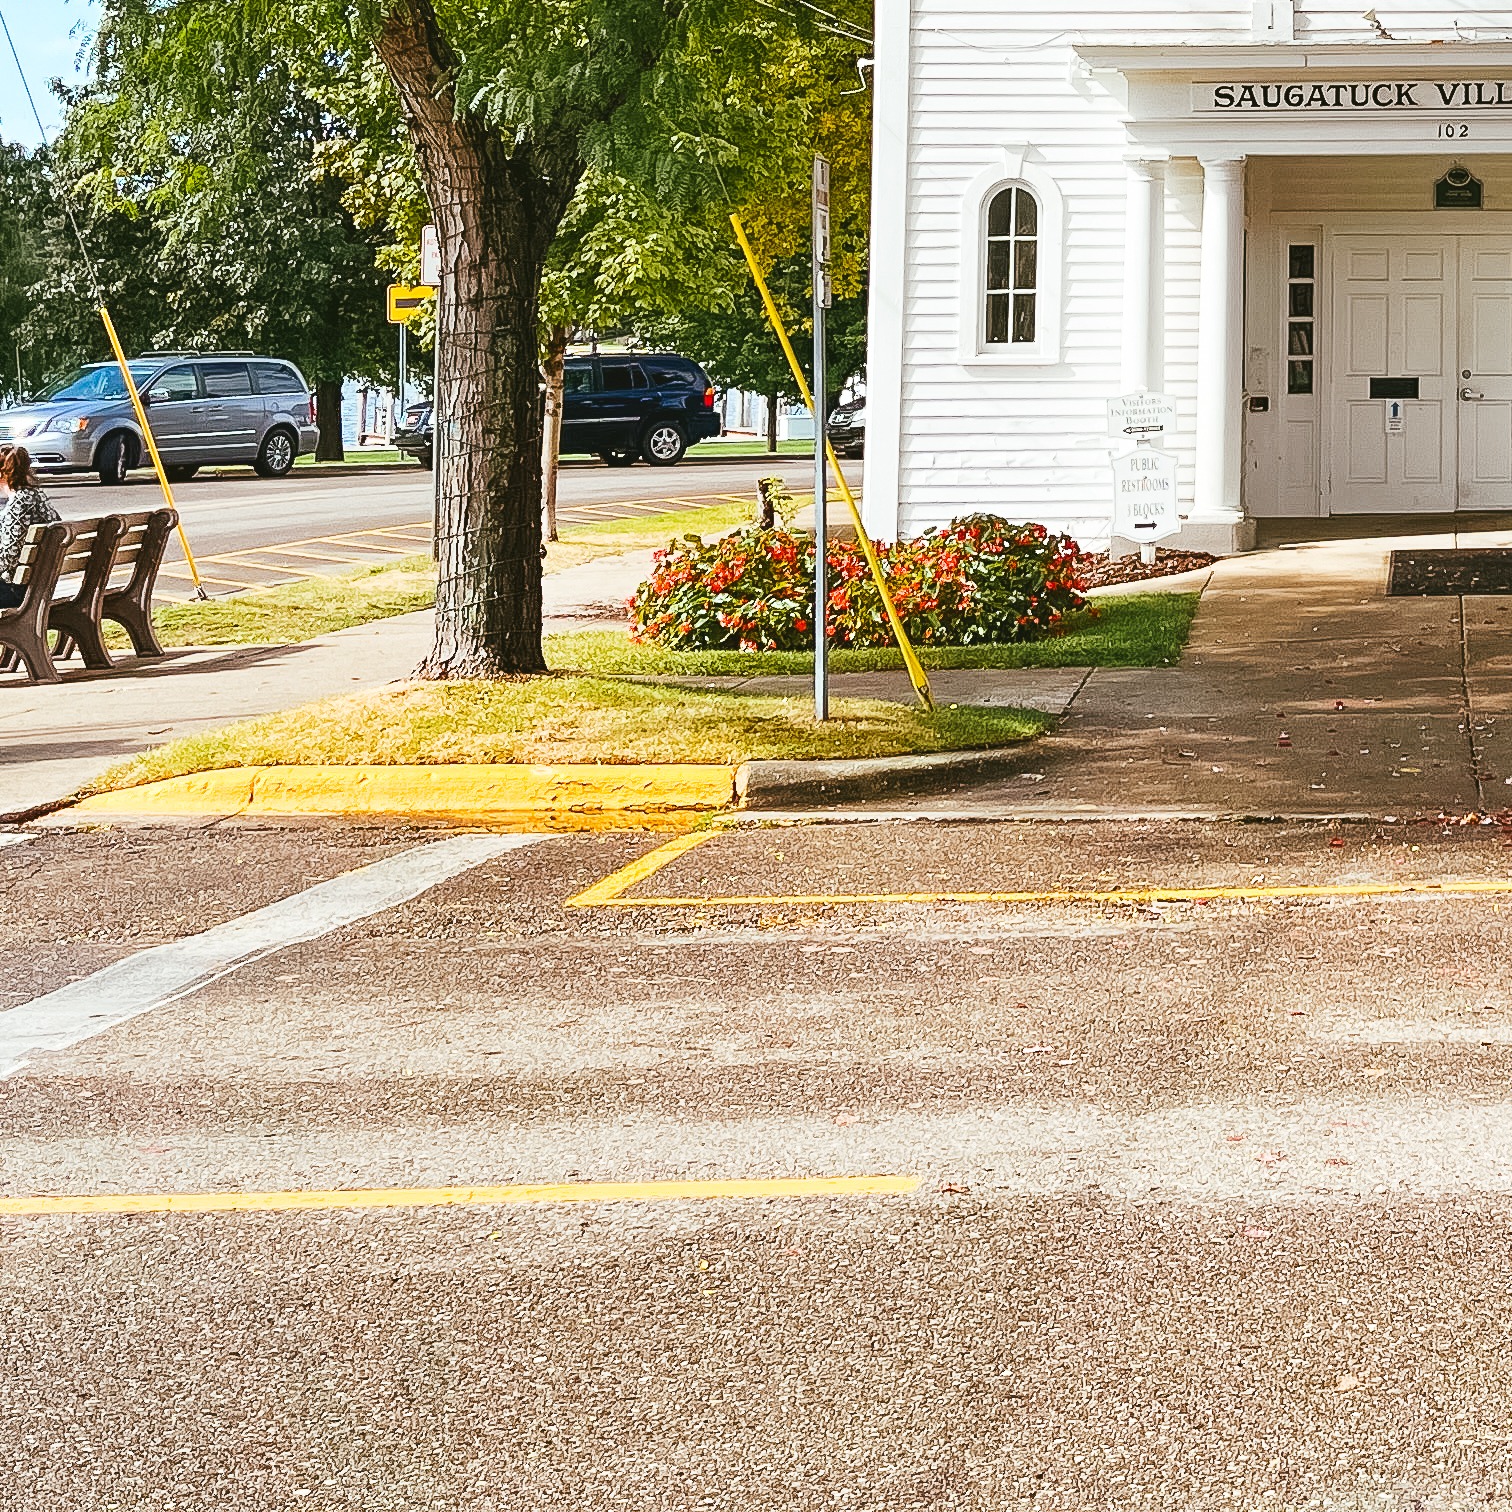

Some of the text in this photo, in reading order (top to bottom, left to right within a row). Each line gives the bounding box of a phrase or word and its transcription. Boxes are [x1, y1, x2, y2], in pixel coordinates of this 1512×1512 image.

[1214, 83, 1419, 107] SAUGATUCK
[1438, 124, 1469, 138] 102
[1130, 457, 1160, 472] PUBLIC
[1121, 478, 1170, 493] RESTROOMS
[1133, 502, 1165, 518] BLOCKS
